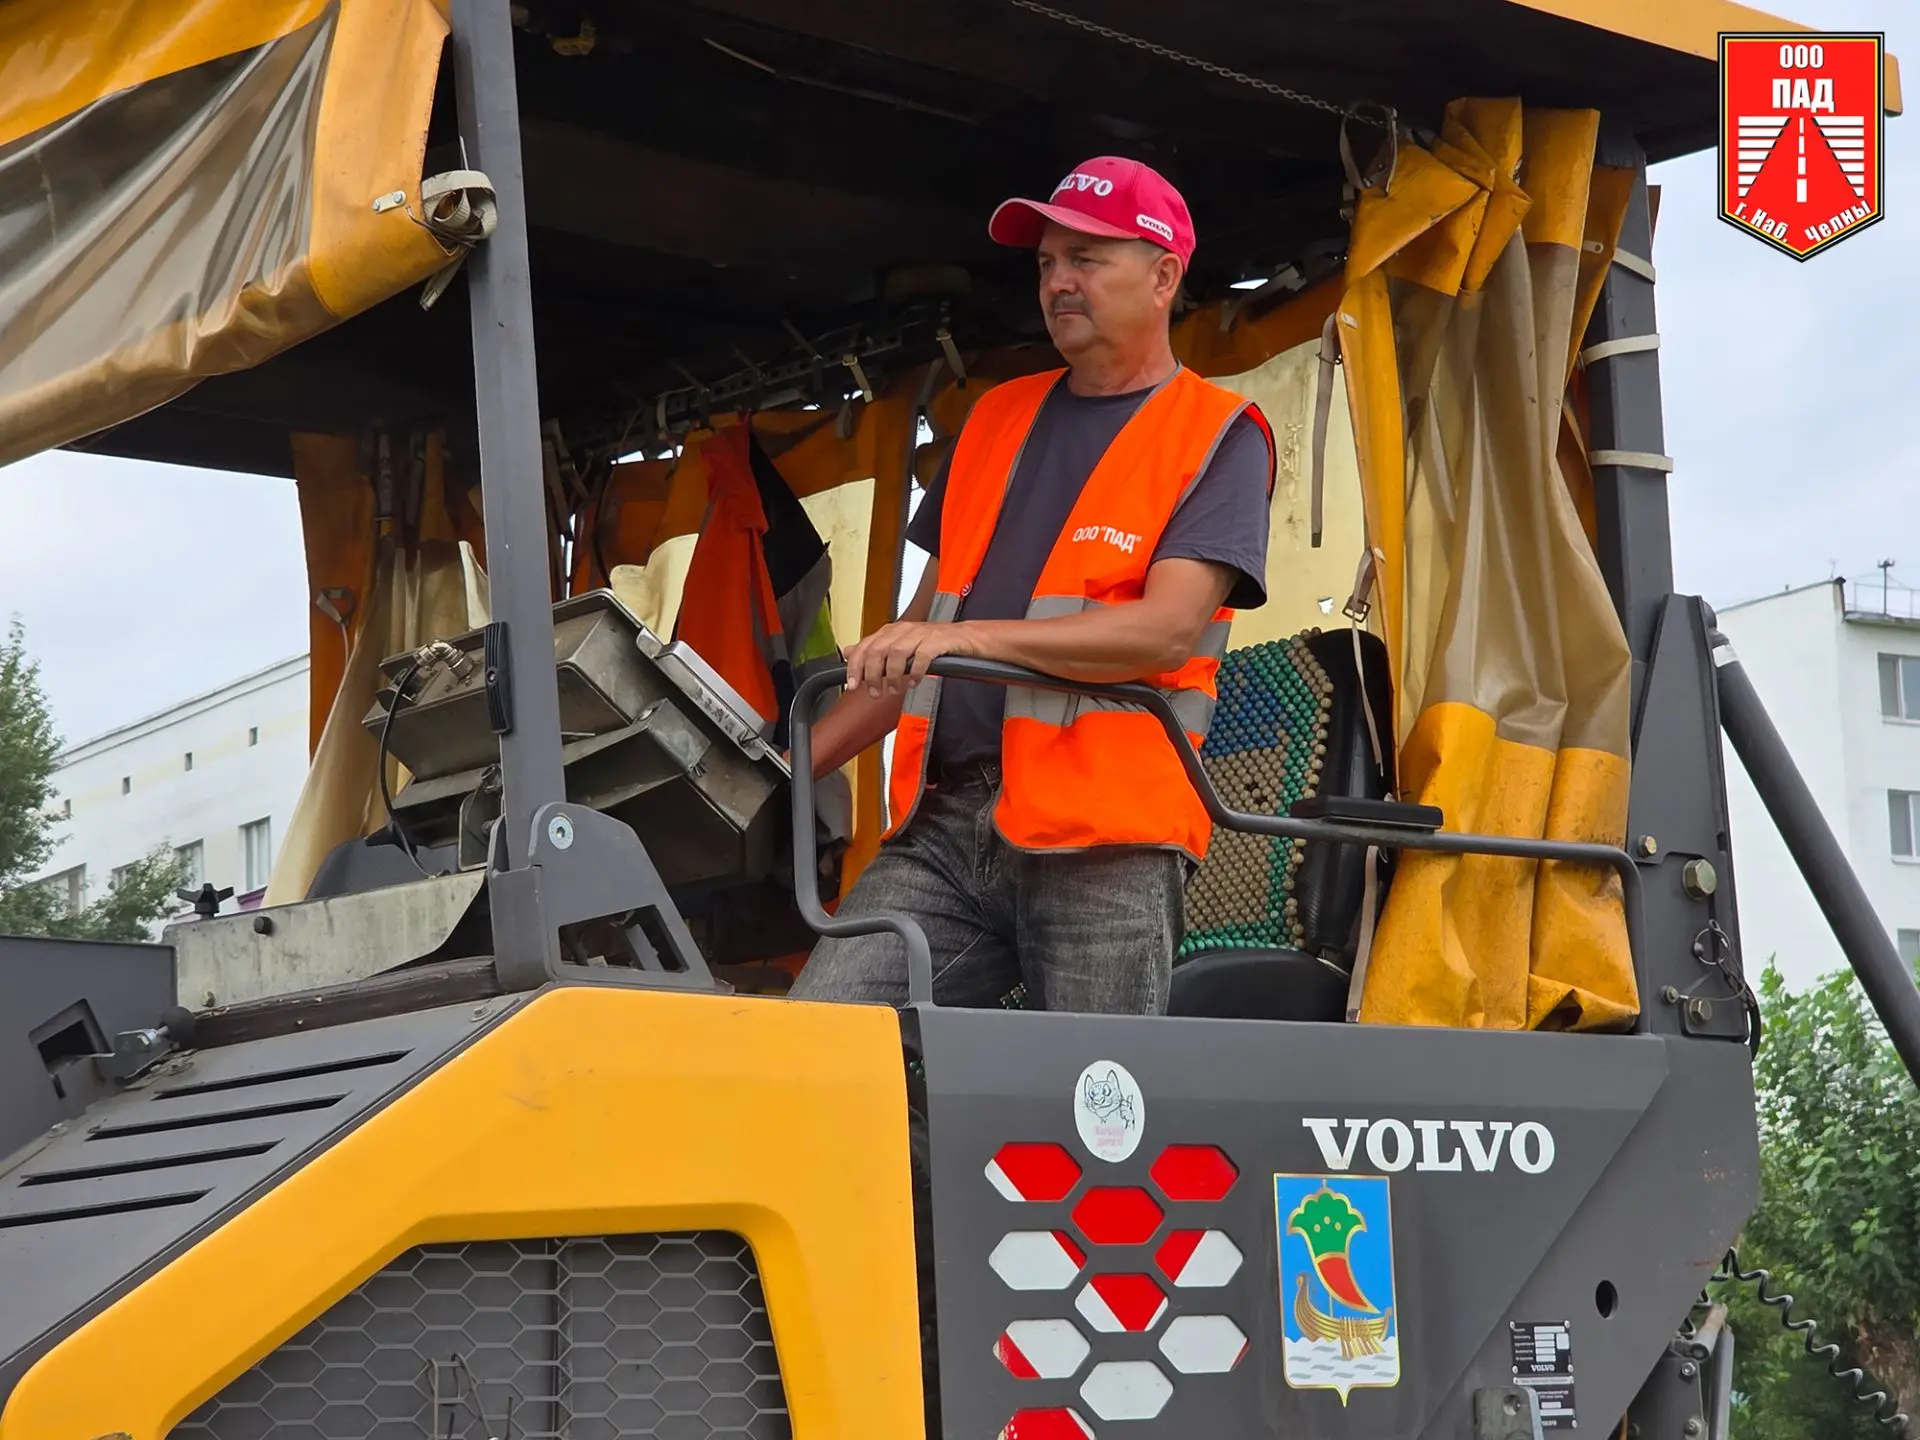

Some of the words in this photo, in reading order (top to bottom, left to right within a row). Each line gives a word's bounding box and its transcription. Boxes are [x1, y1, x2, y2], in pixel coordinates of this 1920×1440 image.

[1072, 525, 1099, 542] ООО
[1101, 525, 1142, 554] "ПАД"
[1302, 1117, 1556, 1174] VOLVO
[1531, 1364, 1555, 1372] VOLVO
